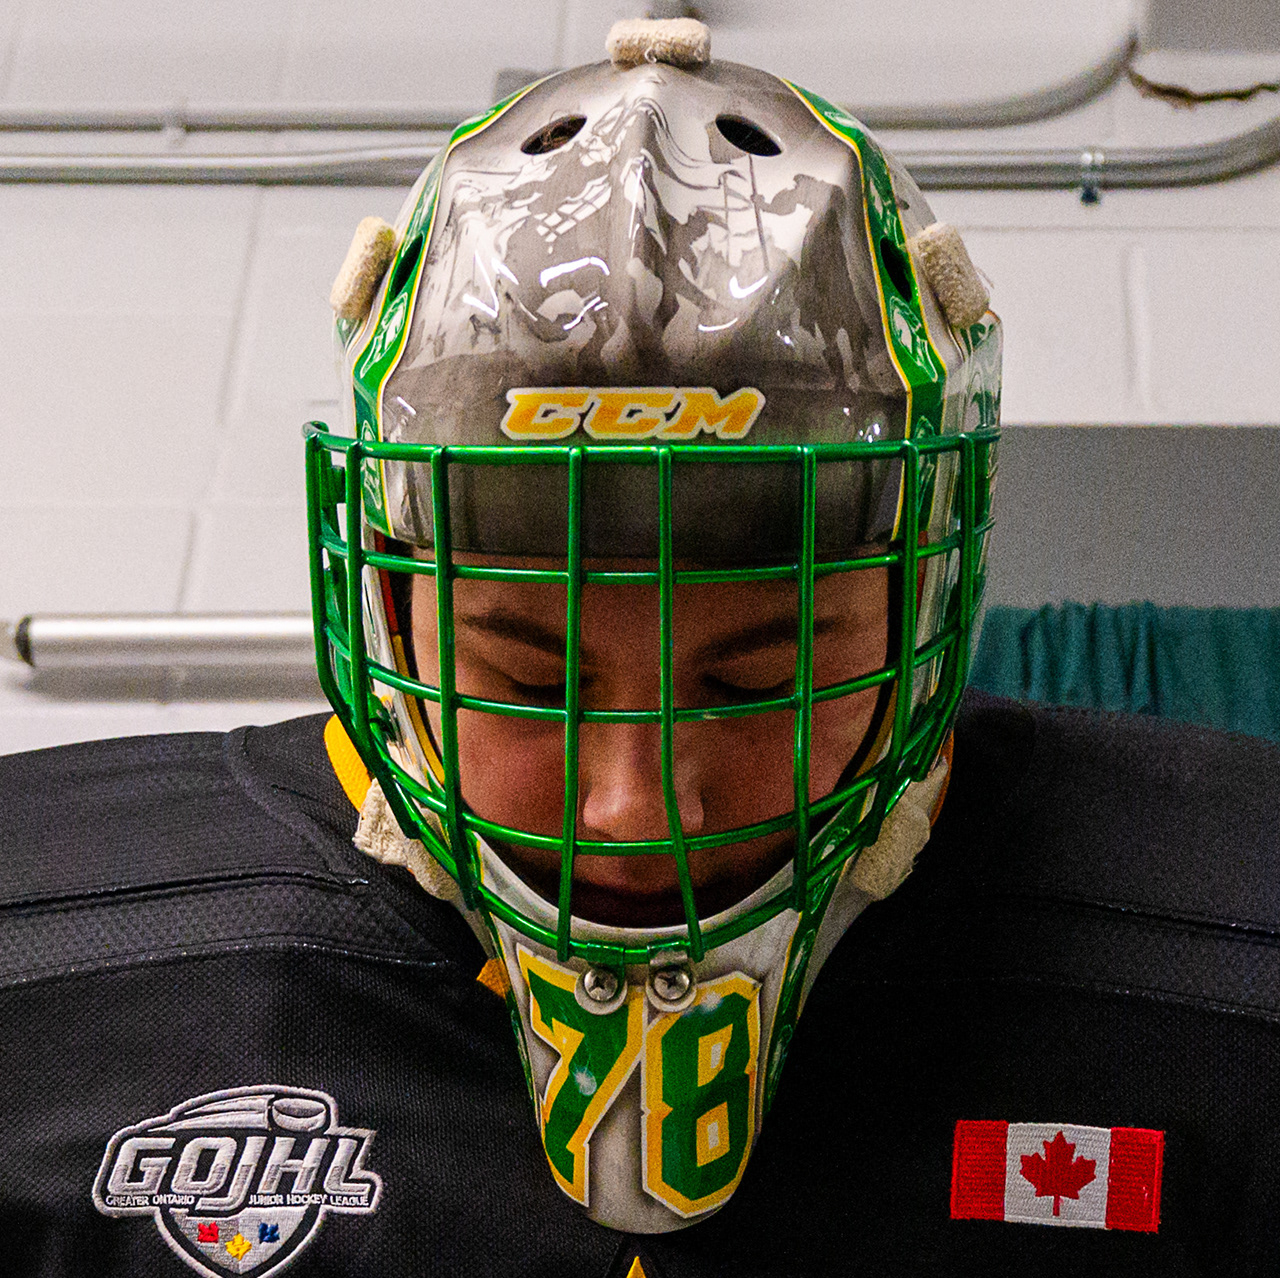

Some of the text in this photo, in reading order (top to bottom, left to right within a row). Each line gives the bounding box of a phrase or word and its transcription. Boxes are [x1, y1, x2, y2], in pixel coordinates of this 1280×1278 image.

[501, 387, 766, 440] CCM
[516, 942, 762, 1219] 78
[105, 1193, 370, 1207] GREATER ONTARIO JUNIOR HOCKEY LEAGUE
[106, 1135, 371, 1211] GOJHL
